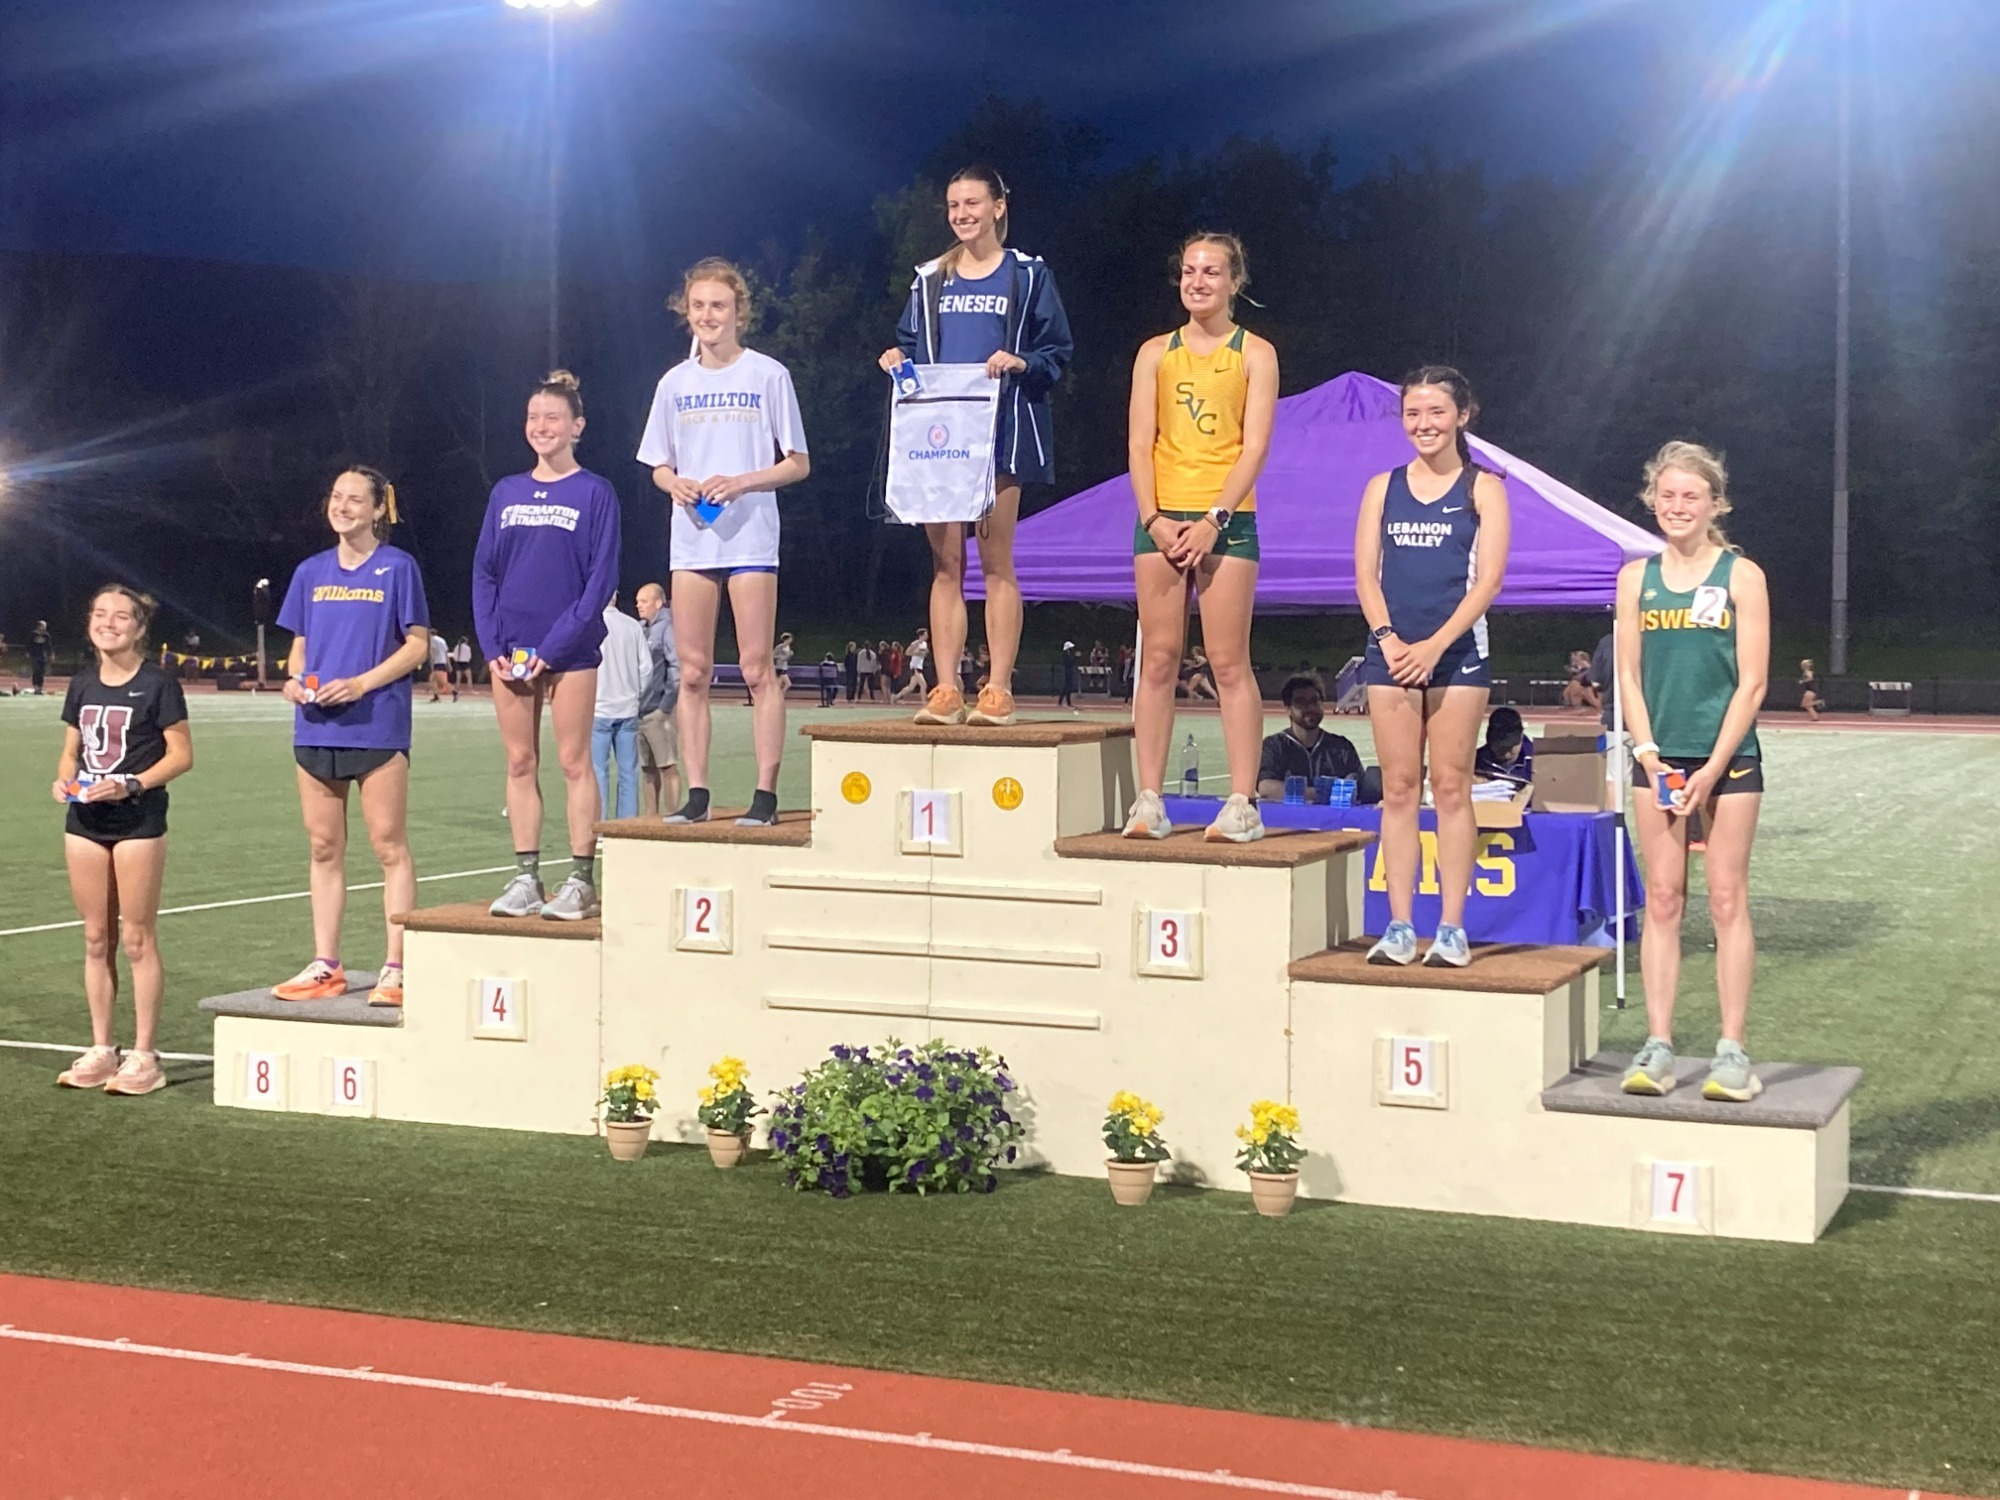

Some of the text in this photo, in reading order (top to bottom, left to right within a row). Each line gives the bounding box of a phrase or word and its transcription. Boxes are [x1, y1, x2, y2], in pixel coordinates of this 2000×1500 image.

[1176, 382, 1217, 436] SVC
[908, 449, 970, 460] CHAMPION
[519, 504, 580, 520] SCRANTON
[1387, 522, 1452, 535] LEBANON
[1393, 534, 1444, 547] VALLEY
[312, 585, 384, 603] Williams
[1697, 588, 1720, 622] 2
[1640, 608, 1731, 632] SWEO
[80, 704, 133, 774] U
[921, 801, 933, 836] 1
[696, 897, 712, 933] 2
[1161, 919, 1178, 958] 3
[492, 987, 507, 1021] 4
[256, 1060, 269, 1093] 8
[343, 1066, 357, 1100] 6
[1404, 1046, 1422, 1086] 5
[1667, 1172, 1685, 1212] 7
[771, 1382, 853, 1410] 100
